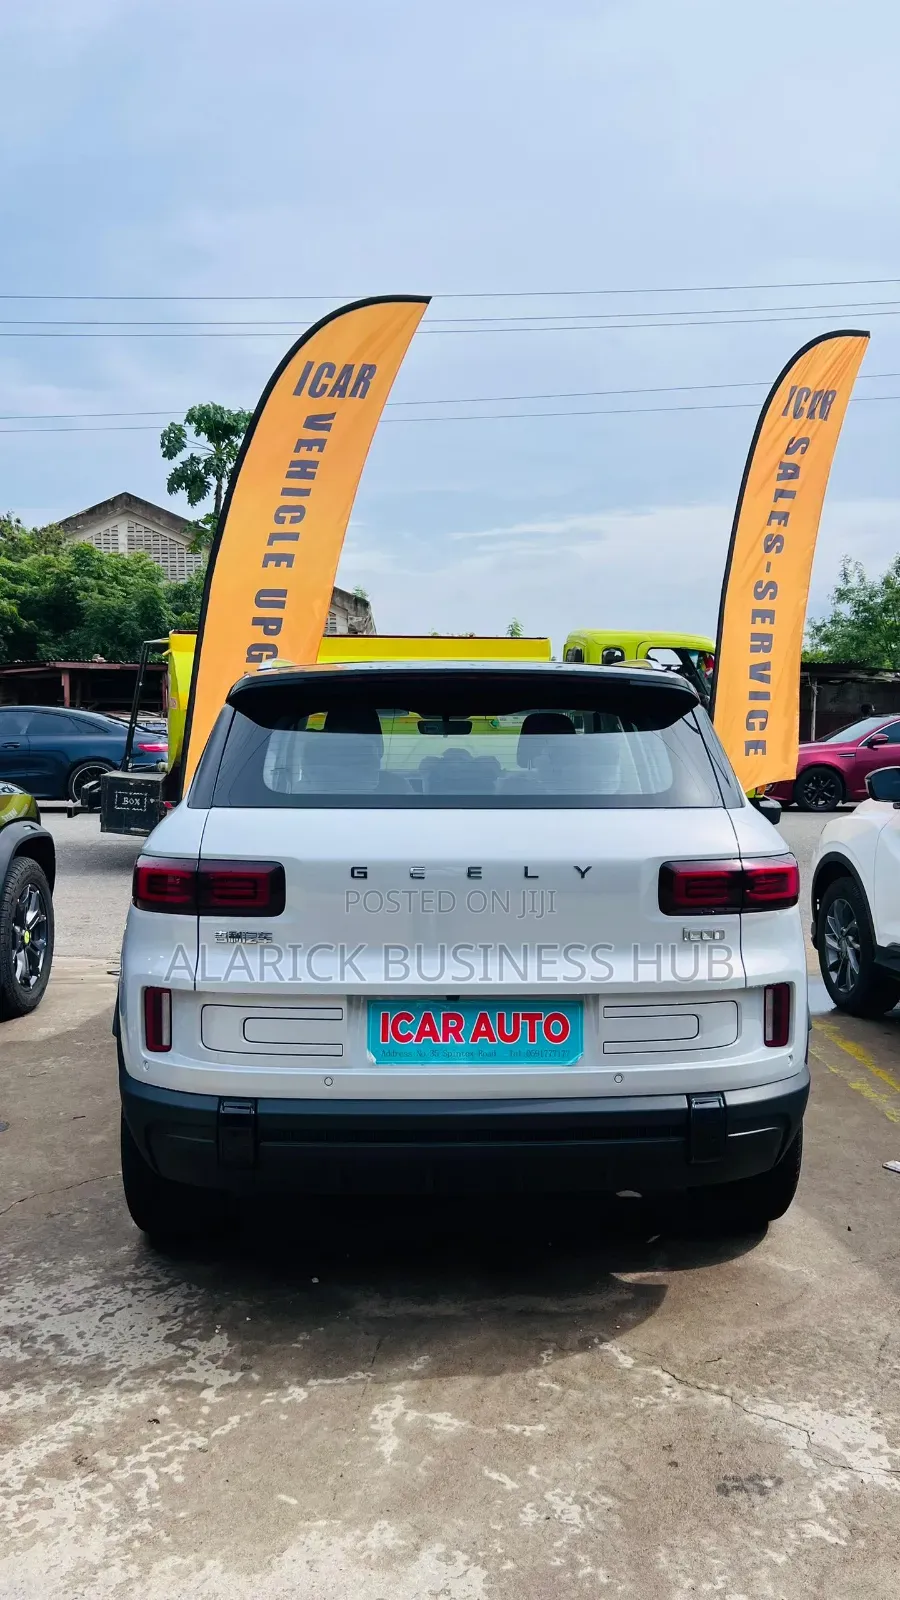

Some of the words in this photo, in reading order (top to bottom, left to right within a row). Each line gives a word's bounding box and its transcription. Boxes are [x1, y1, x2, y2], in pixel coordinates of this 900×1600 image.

[293, 360, 377, 399] ICAR
[262, 411, 337, 568] VEHICLE
[744, 436, 810, 757] SALES-SERVICE
[350, 866, 592, 879] GEELY
[380, 1011, 465, 1044] ICAR
[469, 1011, 571, 1044] AUTO
